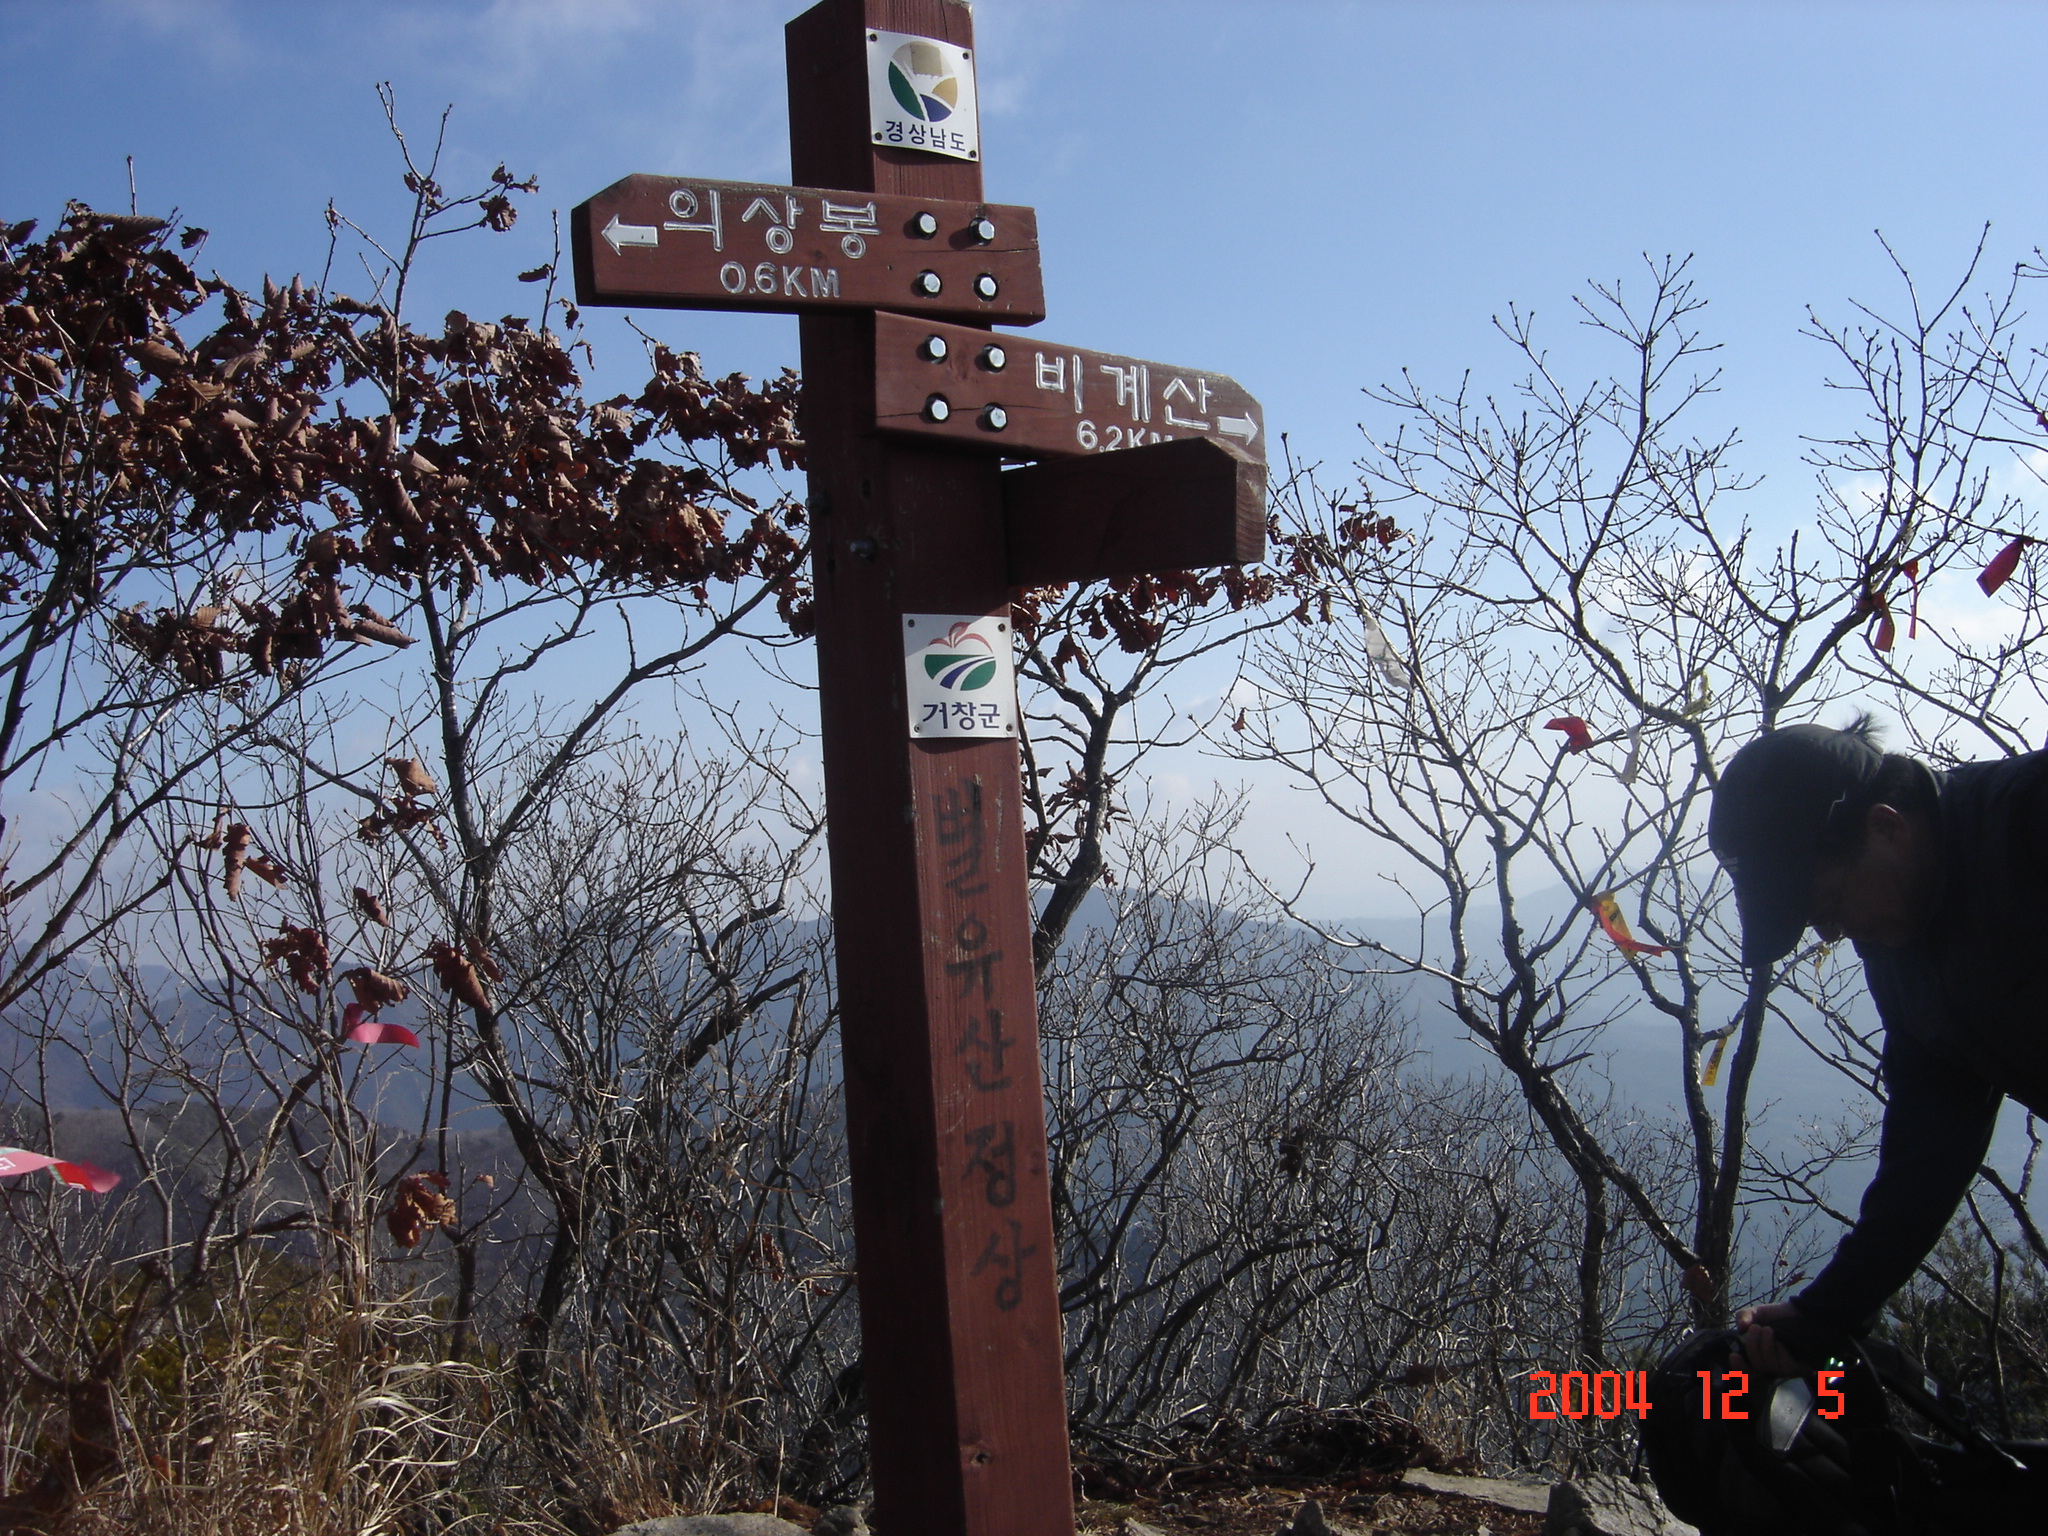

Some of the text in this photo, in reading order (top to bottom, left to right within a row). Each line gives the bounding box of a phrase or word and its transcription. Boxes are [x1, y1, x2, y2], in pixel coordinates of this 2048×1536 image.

[885, 120, 966, 152] 경상남도
[663, 187, 882, 259] 의상봉
[719, 260, 841, 299] 0.6KM
[1035, 351, 1213, 431] 비계산
[922, 701, 1001, 731] 거창군
